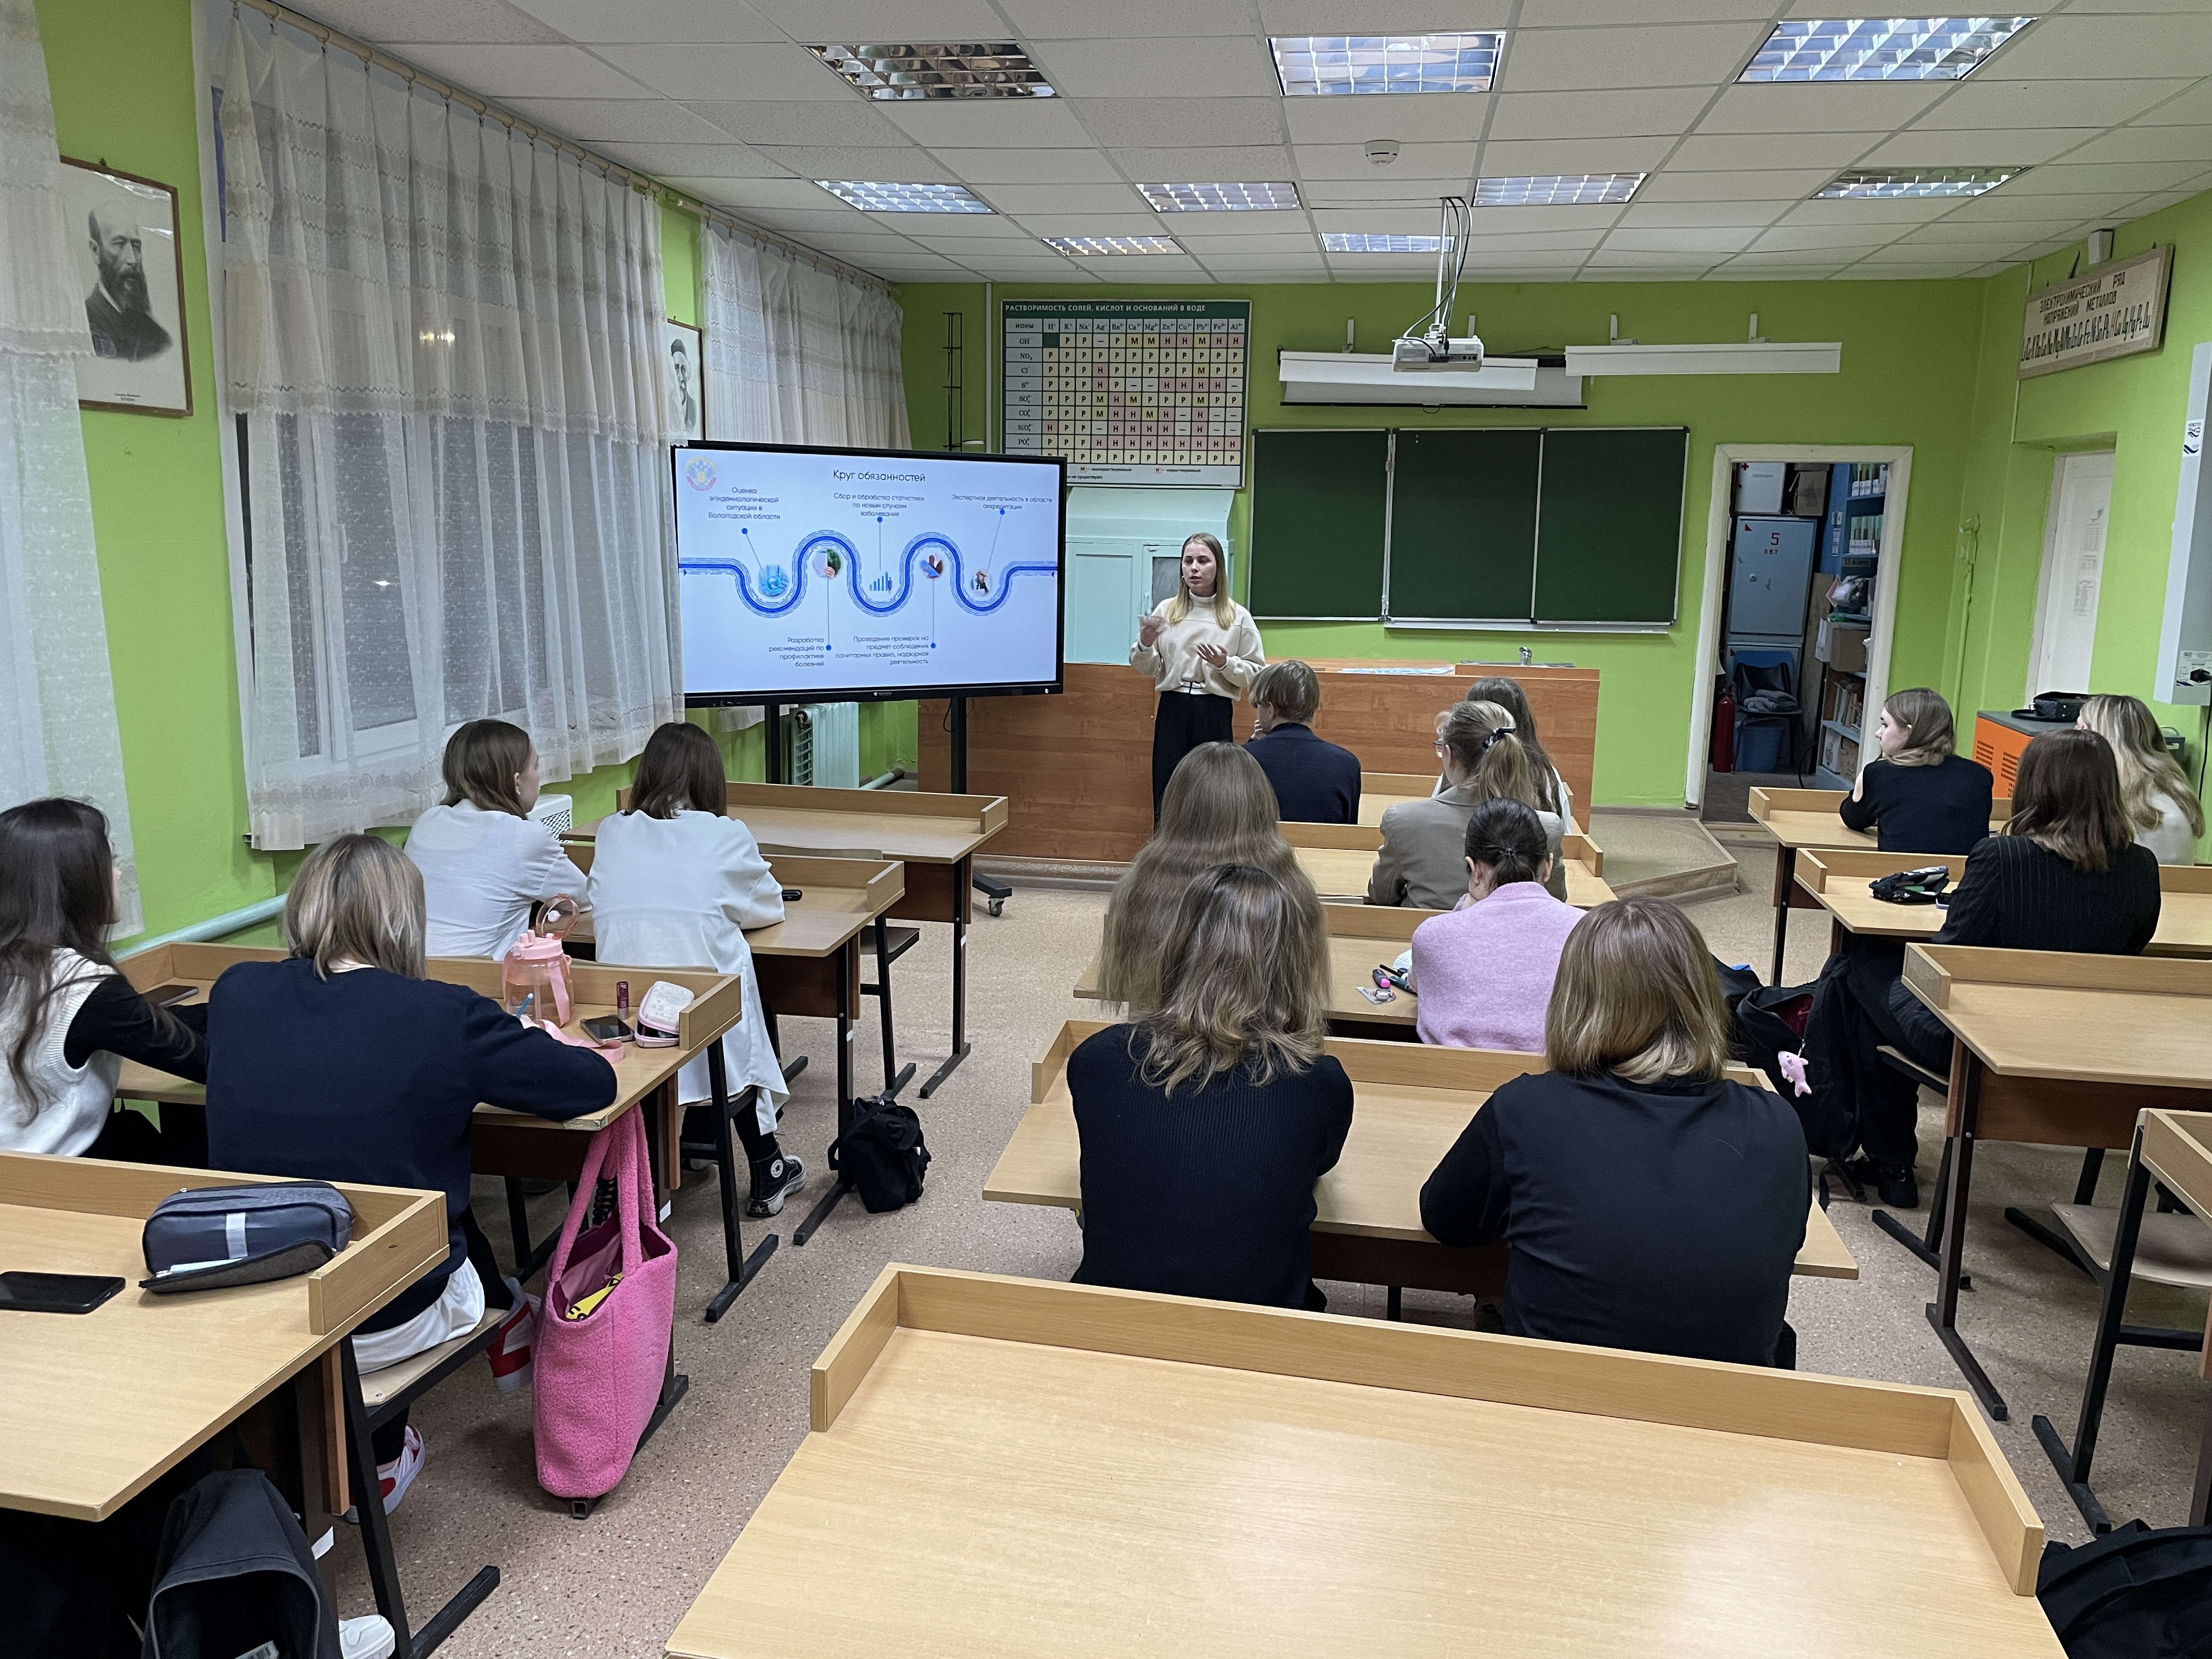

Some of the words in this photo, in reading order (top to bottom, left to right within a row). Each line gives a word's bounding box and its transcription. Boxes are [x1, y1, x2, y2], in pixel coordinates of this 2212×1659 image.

[2113, 272, 2125, 288] РЯД
[2086, 290, 2117, 312] МЕТАЛЛОВ
[833, 470, 856, 481] Круг
[857, 471, 926, 482] обязанностей
[1771, 533, 1780, 545] 5
